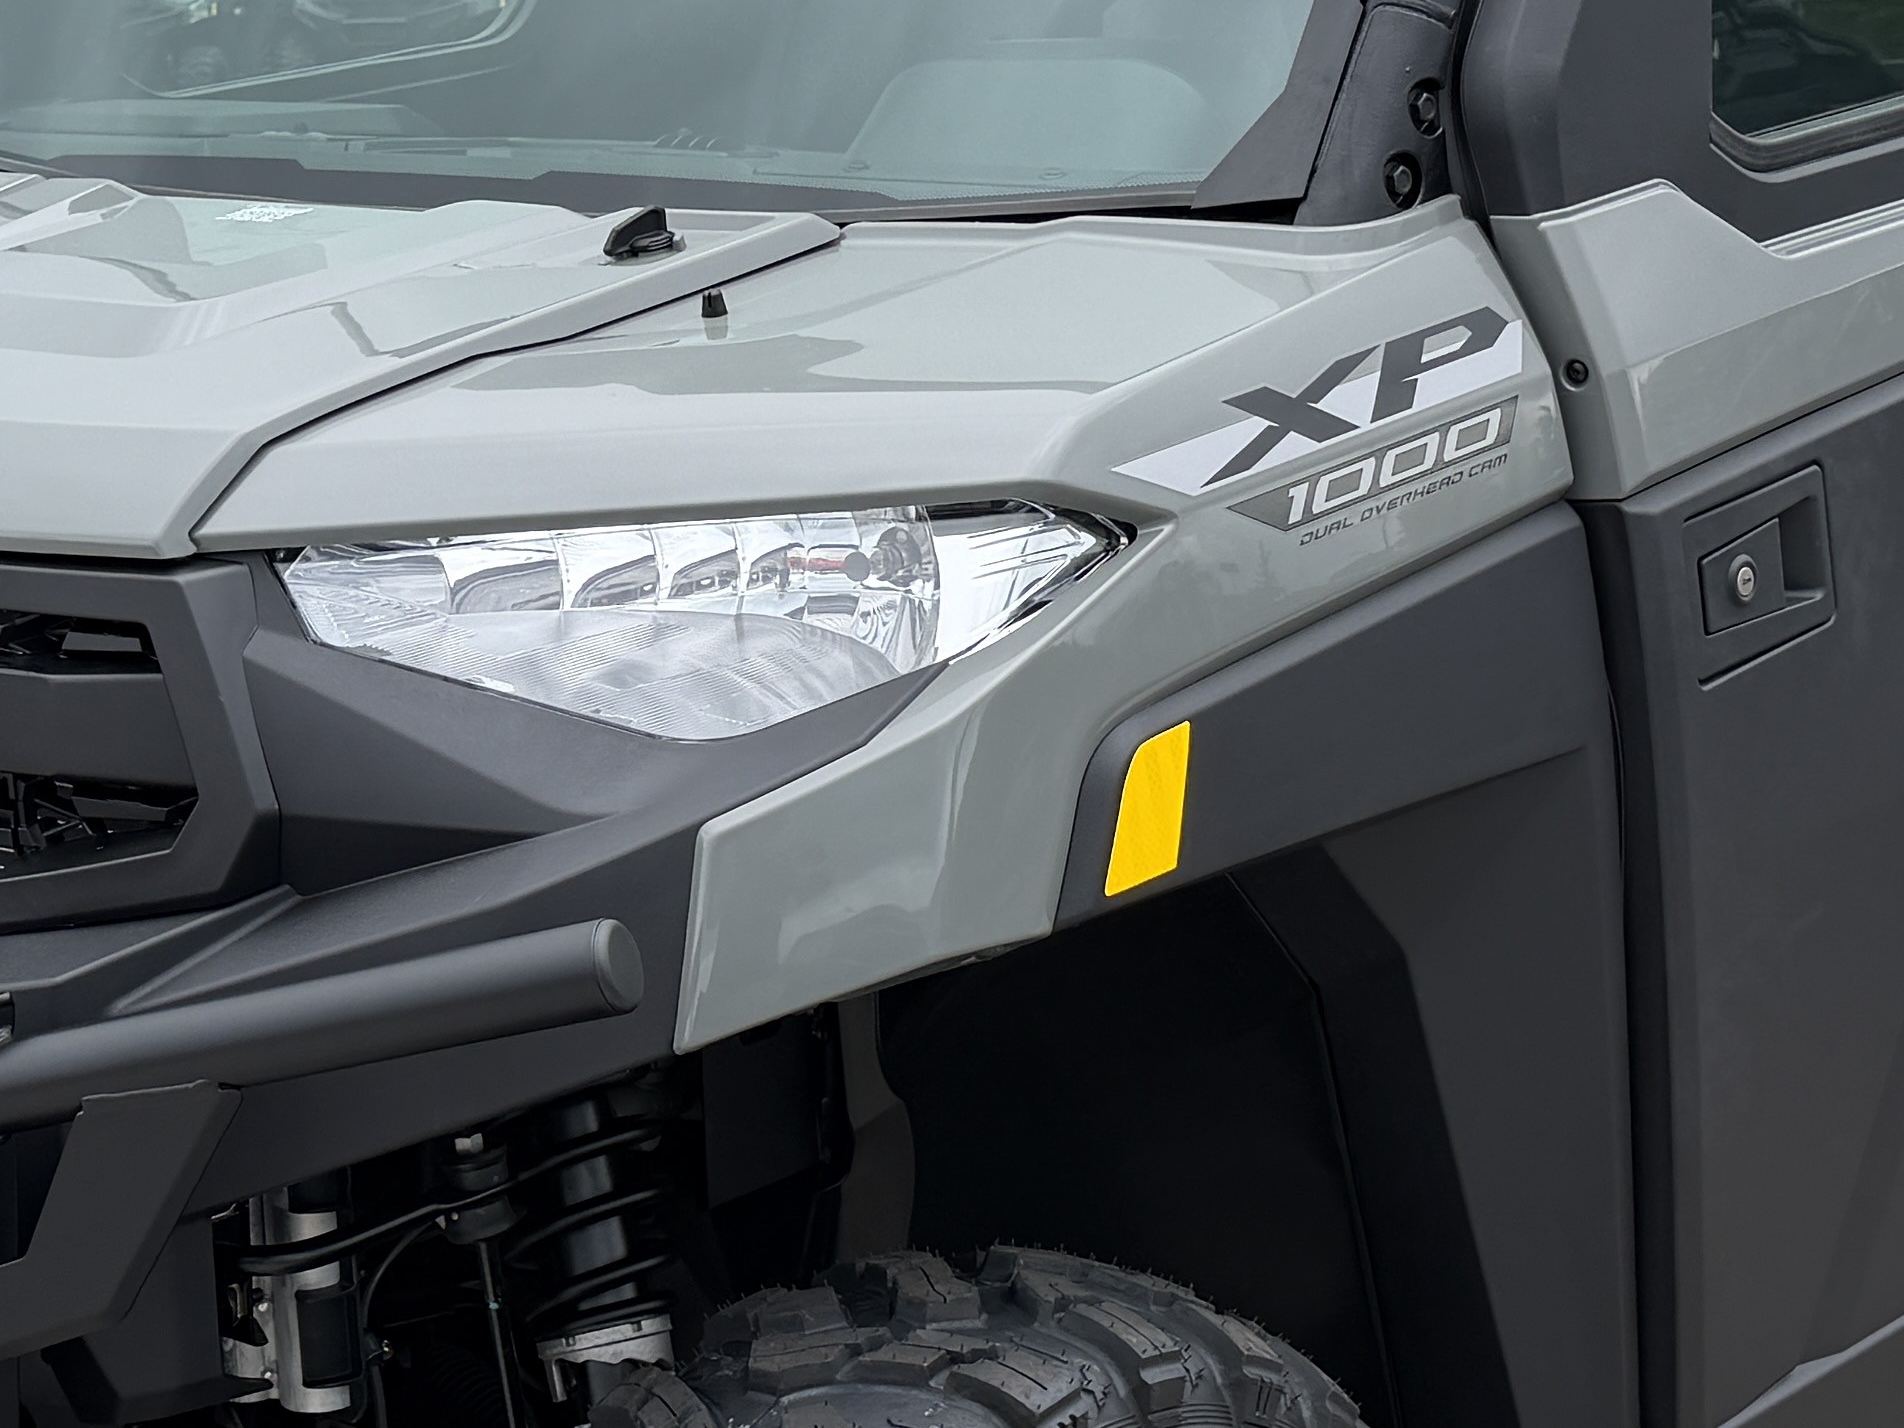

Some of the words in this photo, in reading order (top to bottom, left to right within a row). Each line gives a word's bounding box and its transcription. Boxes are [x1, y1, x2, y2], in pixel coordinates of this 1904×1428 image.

[1201, 305, 1511, 488] XP
[1287, 406, 1503, 524] 1000
[1299, 516, 1354, 547] DUAL
[1360, 470, 1464, 523] OVERHEAD
[1468, 452, 1508, 479] CAM
